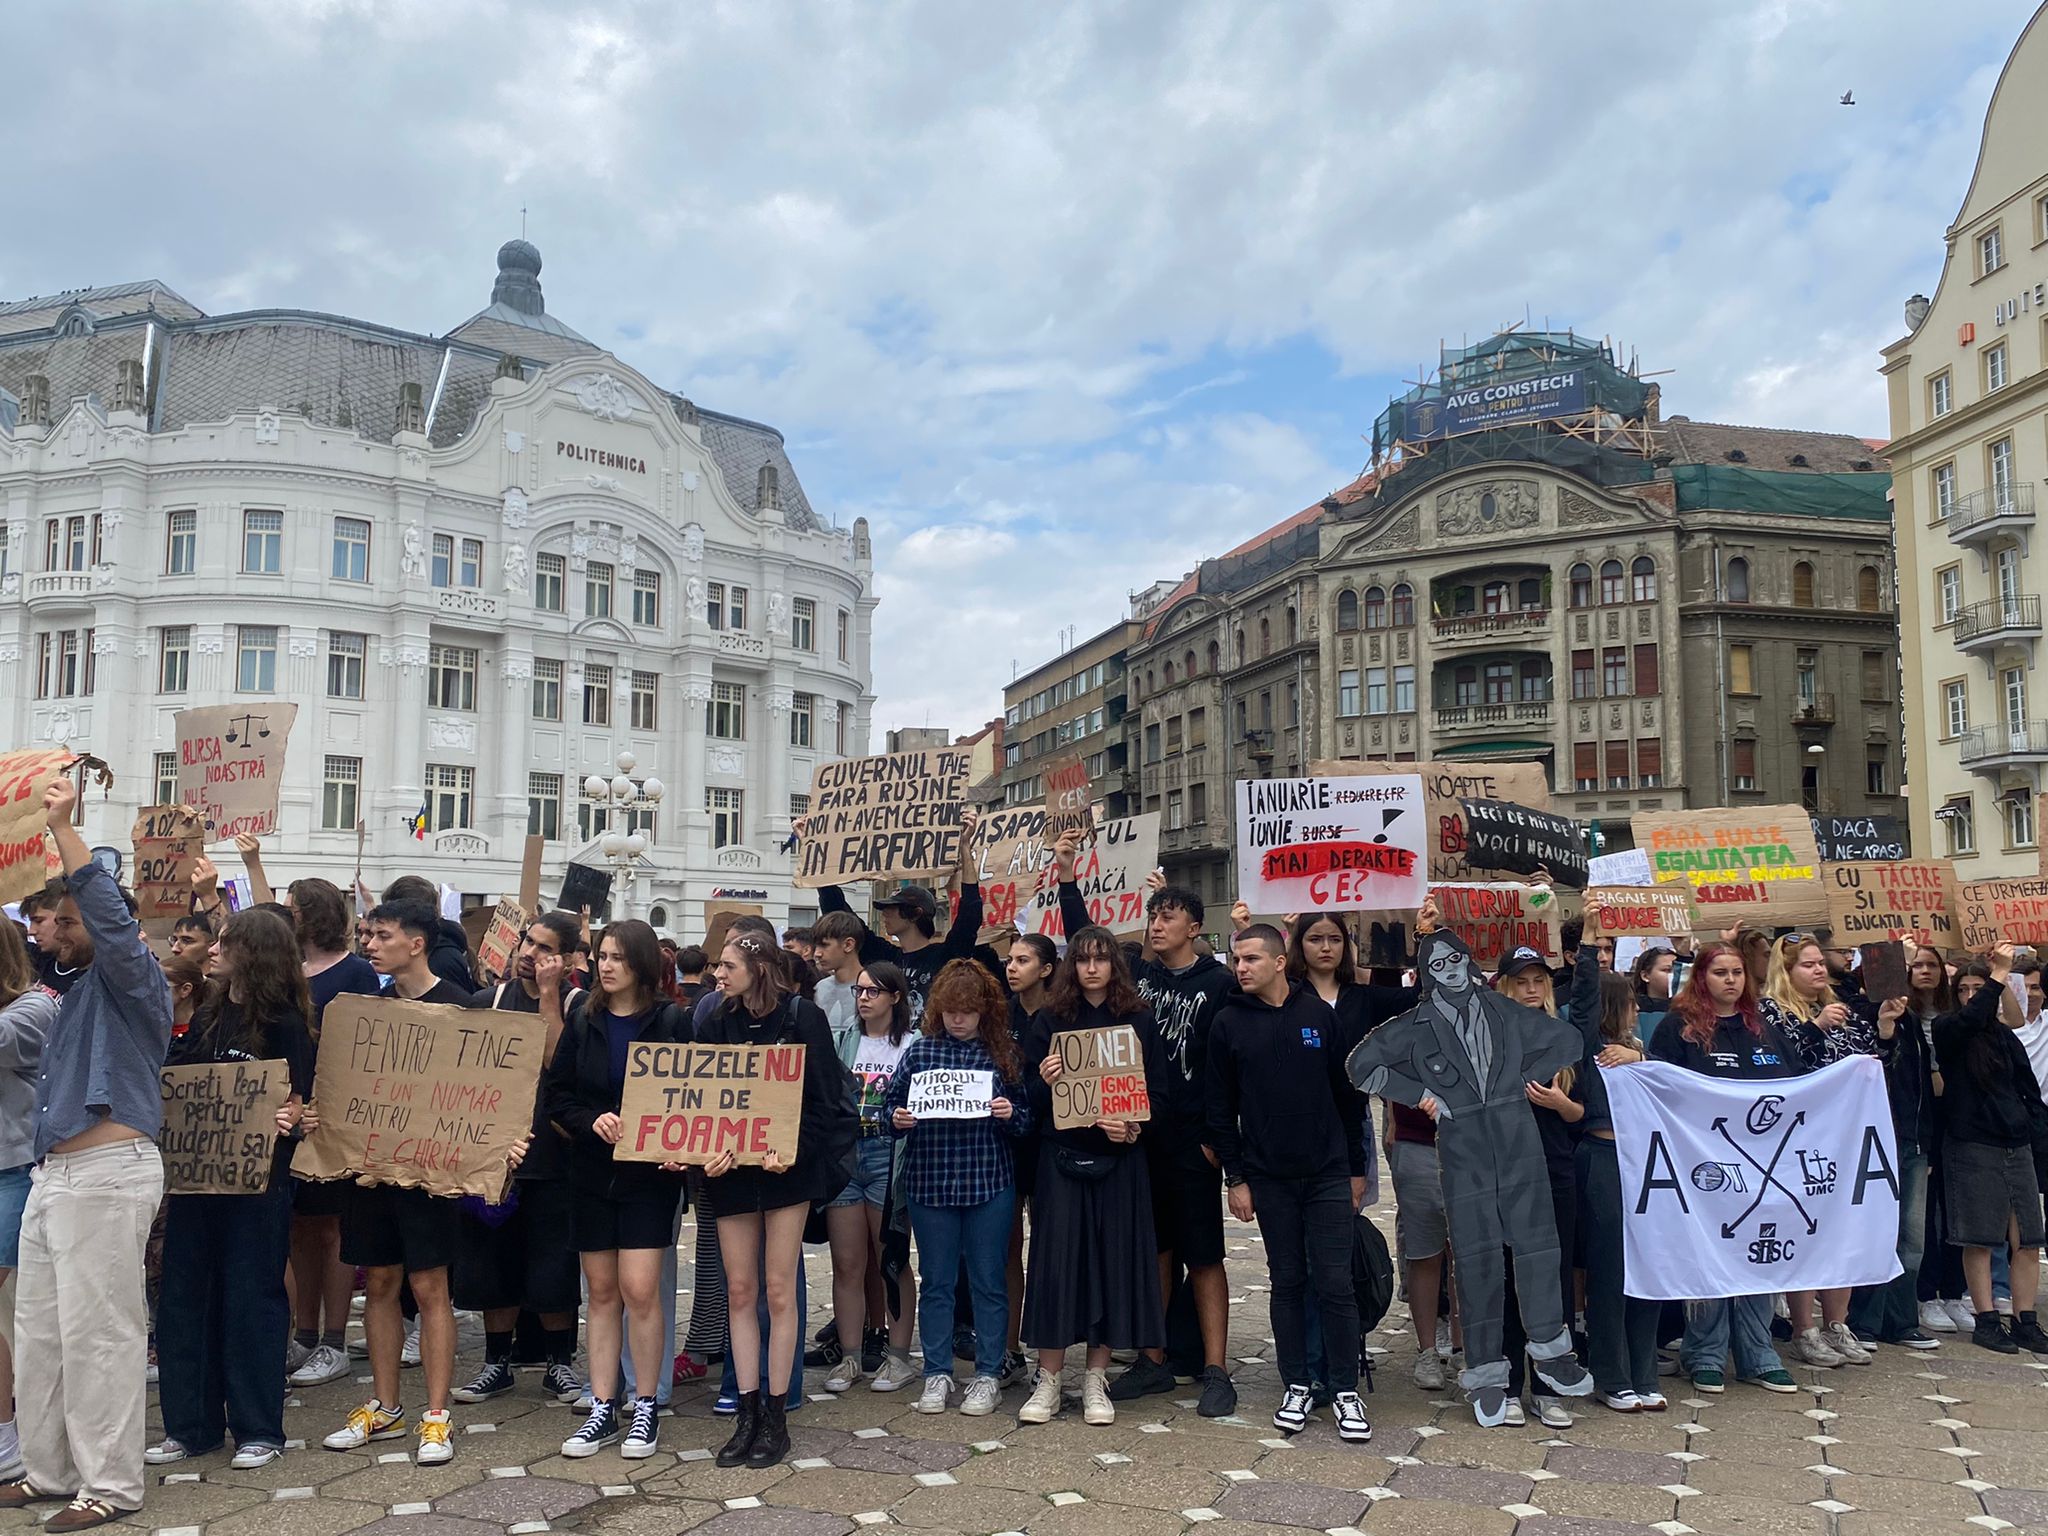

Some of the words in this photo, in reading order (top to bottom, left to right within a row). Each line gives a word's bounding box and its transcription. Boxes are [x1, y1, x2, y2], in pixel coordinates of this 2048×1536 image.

[1446, 392, 1480, 410] AVG
[1484, 374, 1574, 402] CONSTECH
[557, 441, 646, 474] POLITEHNICA
[182, 737, 222, 766] BURSA
[818, 752, 931, 789] GUVERNUL
[1428, 776, 1499, 801] NOAPTE
[144, 813, 177, 837] 10%
[805, 814, 829, 837] NOI
[834, 804, 900, 833] N-AVEM
[1507, 808, 1525, 826] DE
[1552, 821, 1569, 837] DE
[1832, 818, 1878, 838] DACĂ
[802, 839, 829, 877] ÎN
[838, 830, 960, 875] FARFURIE
[1475, 831, 1518, 853] VOCI
[1655, 844, 1797, 872] EGALITATEA
[141, 858, 178, 882] 90%
[1269, 853, 1308, 876] MAI
[1835, 867, 1861, 888] CU
[1310, 870, 1369, 905] CE?
[1597, 891, 1647, 904] BAGAJE
[1652, 890, 1686, 905] PLINE
[1855, 890, 1875, 910] SI
[1886, 890, 1946, 911] REFUZ
[1963, 885, 1985, 902] CE
[1600, 905, 1660, 930] BURSE
[1911, 915, 1919, 929] E
[1930, 912, 1951, 931] ÎN
[351, 1017, 437, 1075] PENTRU
[457, 1029, 523, 1069] TINE
[1052, 1032, 1095, 1074] 10%
[1096, 1027, 1136, 1068] NET
[630, 1045, 760, 1079] SCUZELE
[764, 1048, 802, 1082] NU
[233, 1066, 268, 1110] legi
[372, 1078, 385, 1095] E
[390, 1081, 413, 1101] UN
[430, 1080, 503, 1114] NUMĂR
[663, 1081, 703, 1113] ȚIN
[719, 1089, 751, 1109] DE
[1054, 1080, 1099, 1119] 90%
[183, 1099, 243, 1126] pentru
[345, 1097, 412, 1133] PENTRU
[433, 1116, 496, 1145] MINE
[635, 1114, 771, 1153] FOAME
[363, 1134, 380, 1168] E
[393, 1138, 463, 1171] CHIRIA
[1850, 1126, 1900, 1205] A
[1635, 1131, 1690, 1214] A
[1805, 1183, 1835, 1196] UMC
